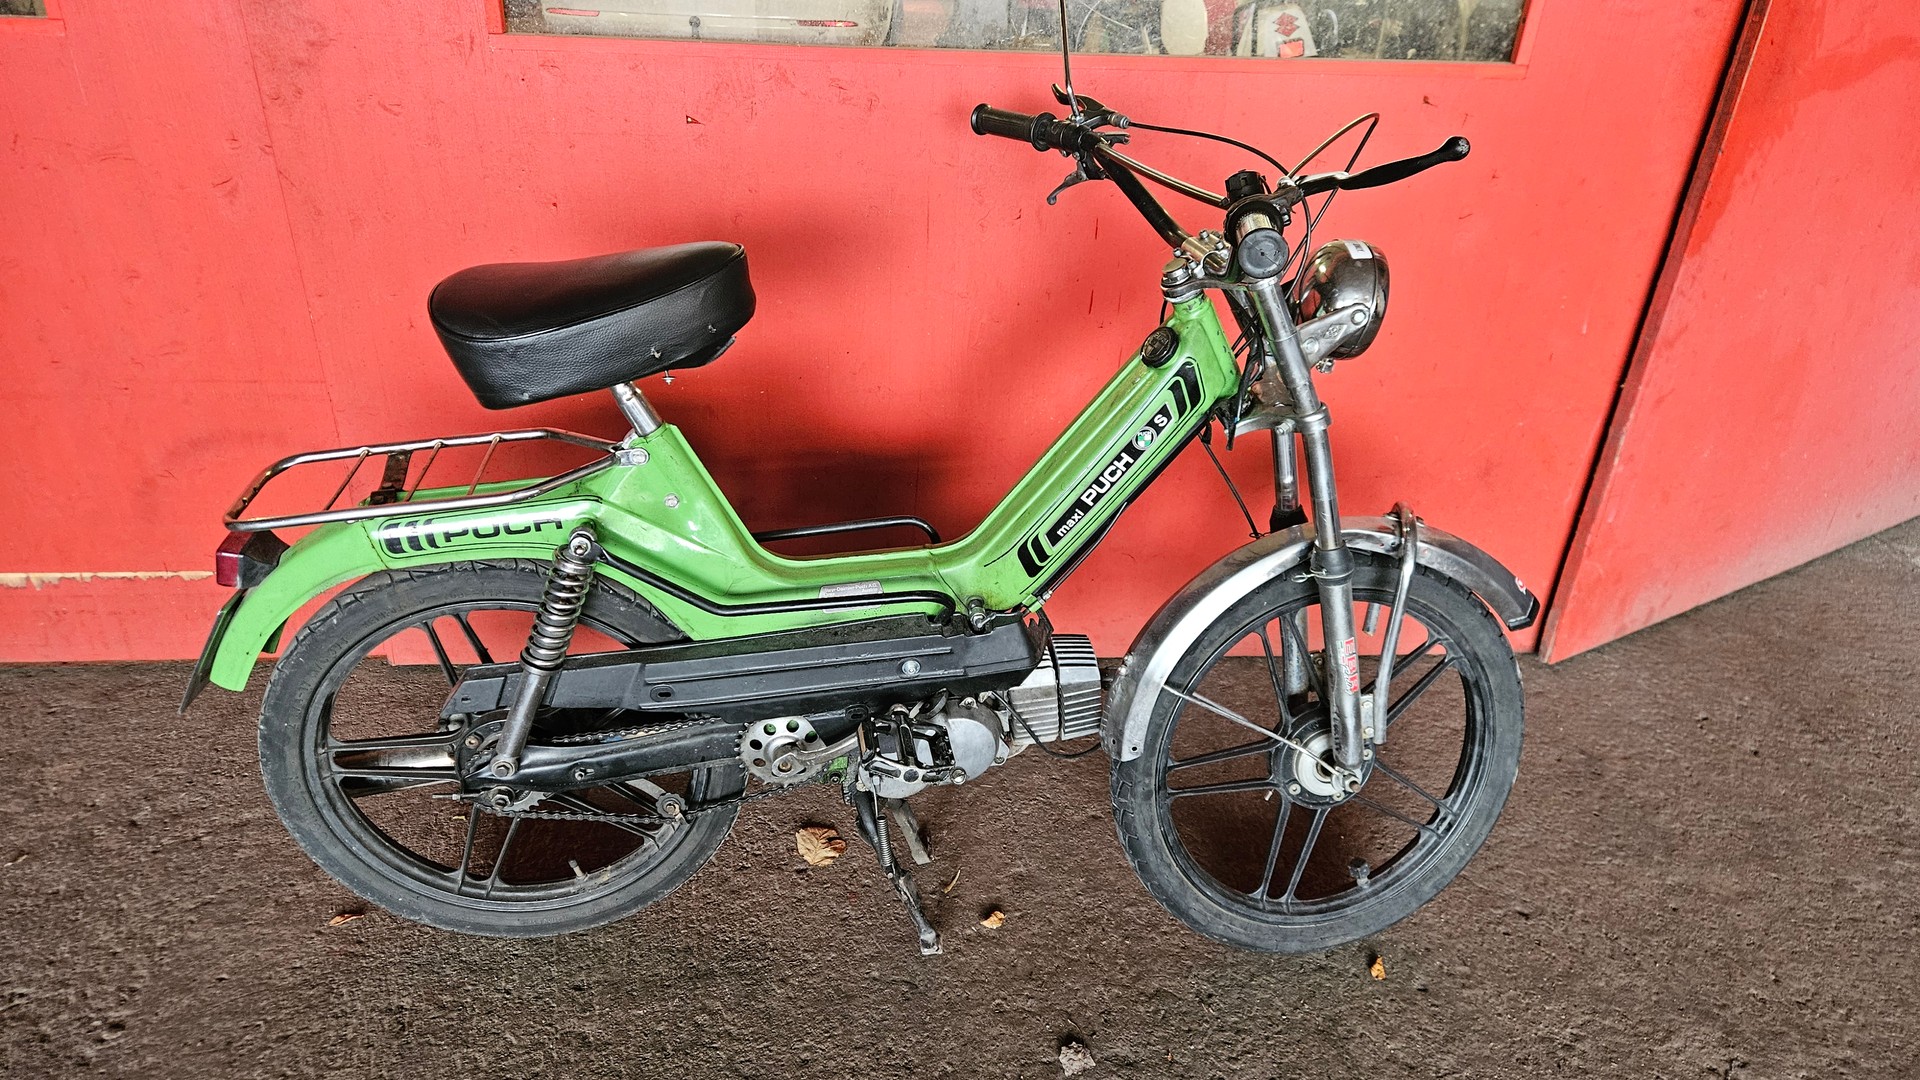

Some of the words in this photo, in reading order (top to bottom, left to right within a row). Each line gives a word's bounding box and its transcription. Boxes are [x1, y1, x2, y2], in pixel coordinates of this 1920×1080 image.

[1056, 509, 1085, 537] maxi
[1080, 452, 1135, 507] PUCH
[1153, 413, 1168, 427] S
